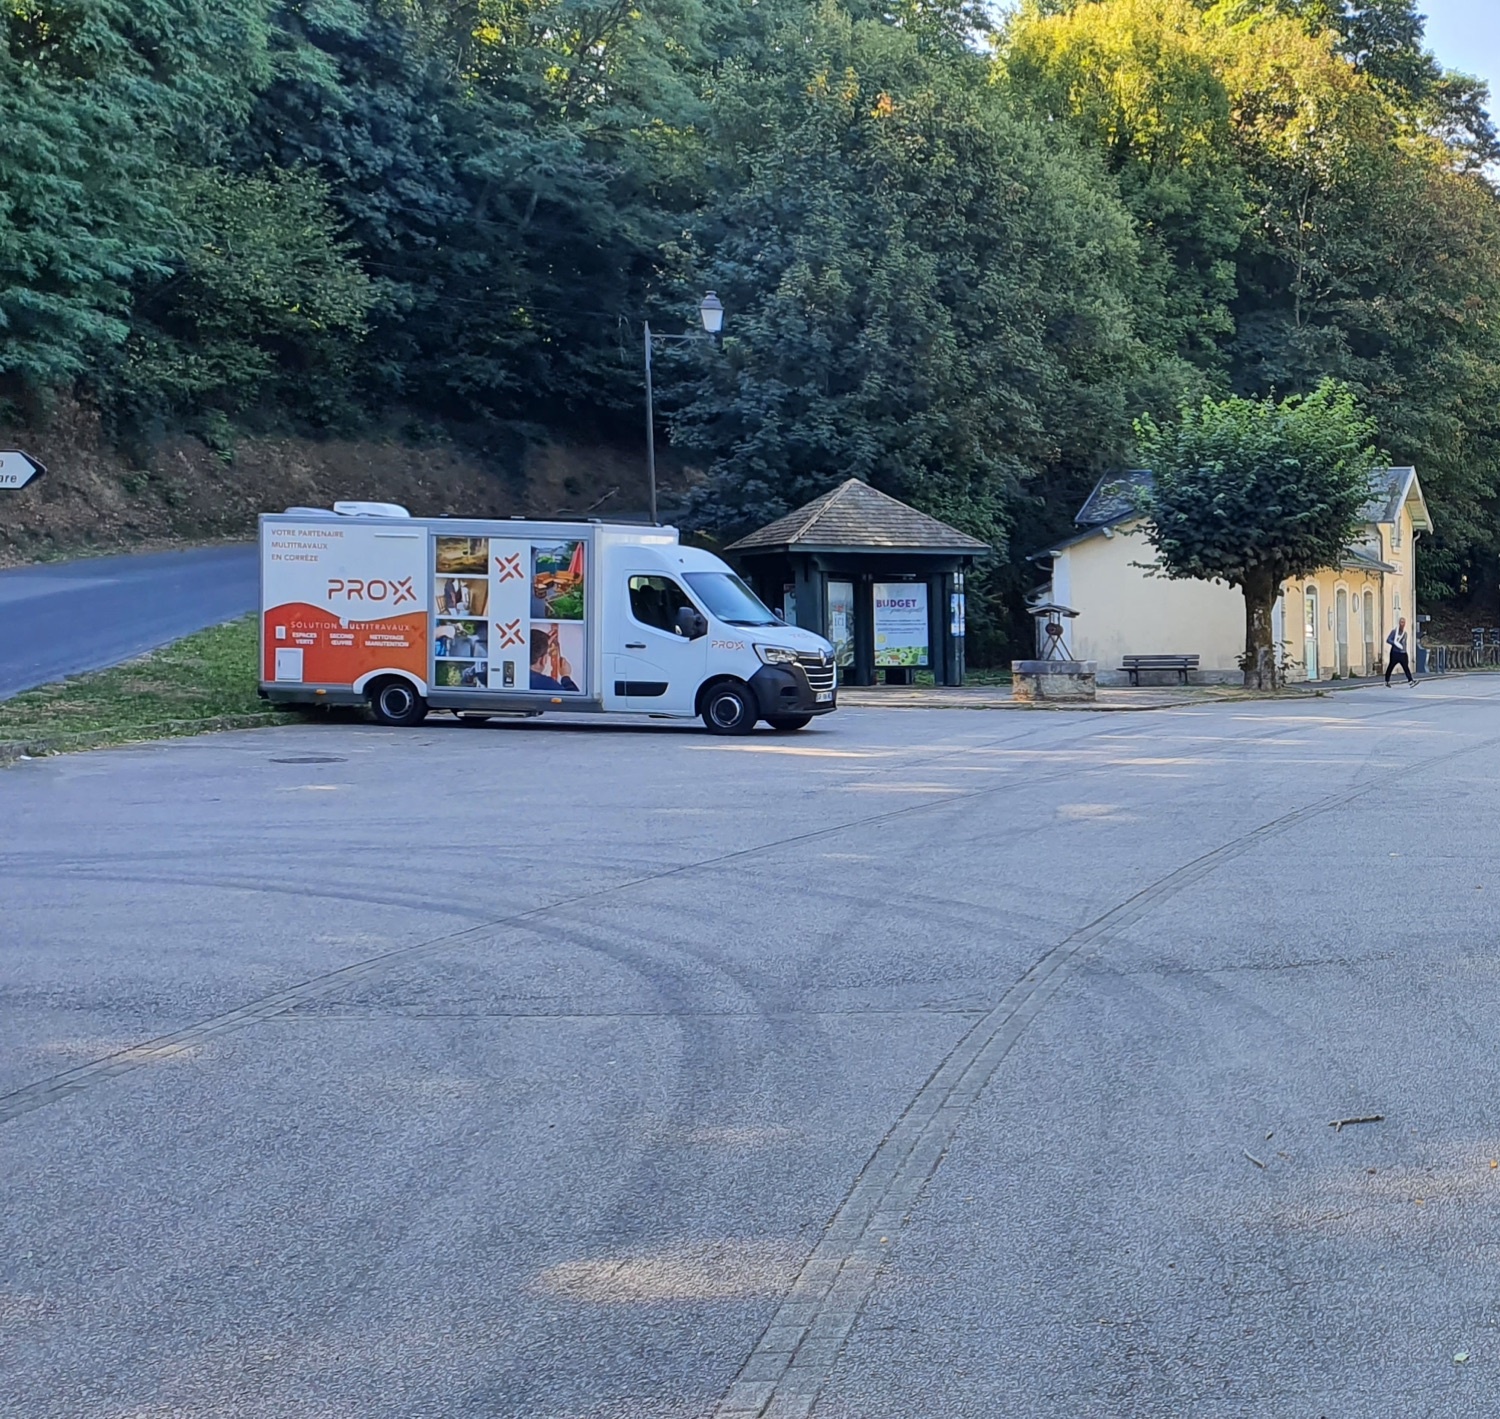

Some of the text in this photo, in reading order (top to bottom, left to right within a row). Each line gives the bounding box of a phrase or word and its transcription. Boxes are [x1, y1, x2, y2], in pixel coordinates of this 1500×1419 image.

[298, 529, 344, 538] PARTENAIRE
[271, 553, 282, 561] EN
[876, 599, 917, 608] BUDGET
[290, 621, 337, 629] SOLUTION
